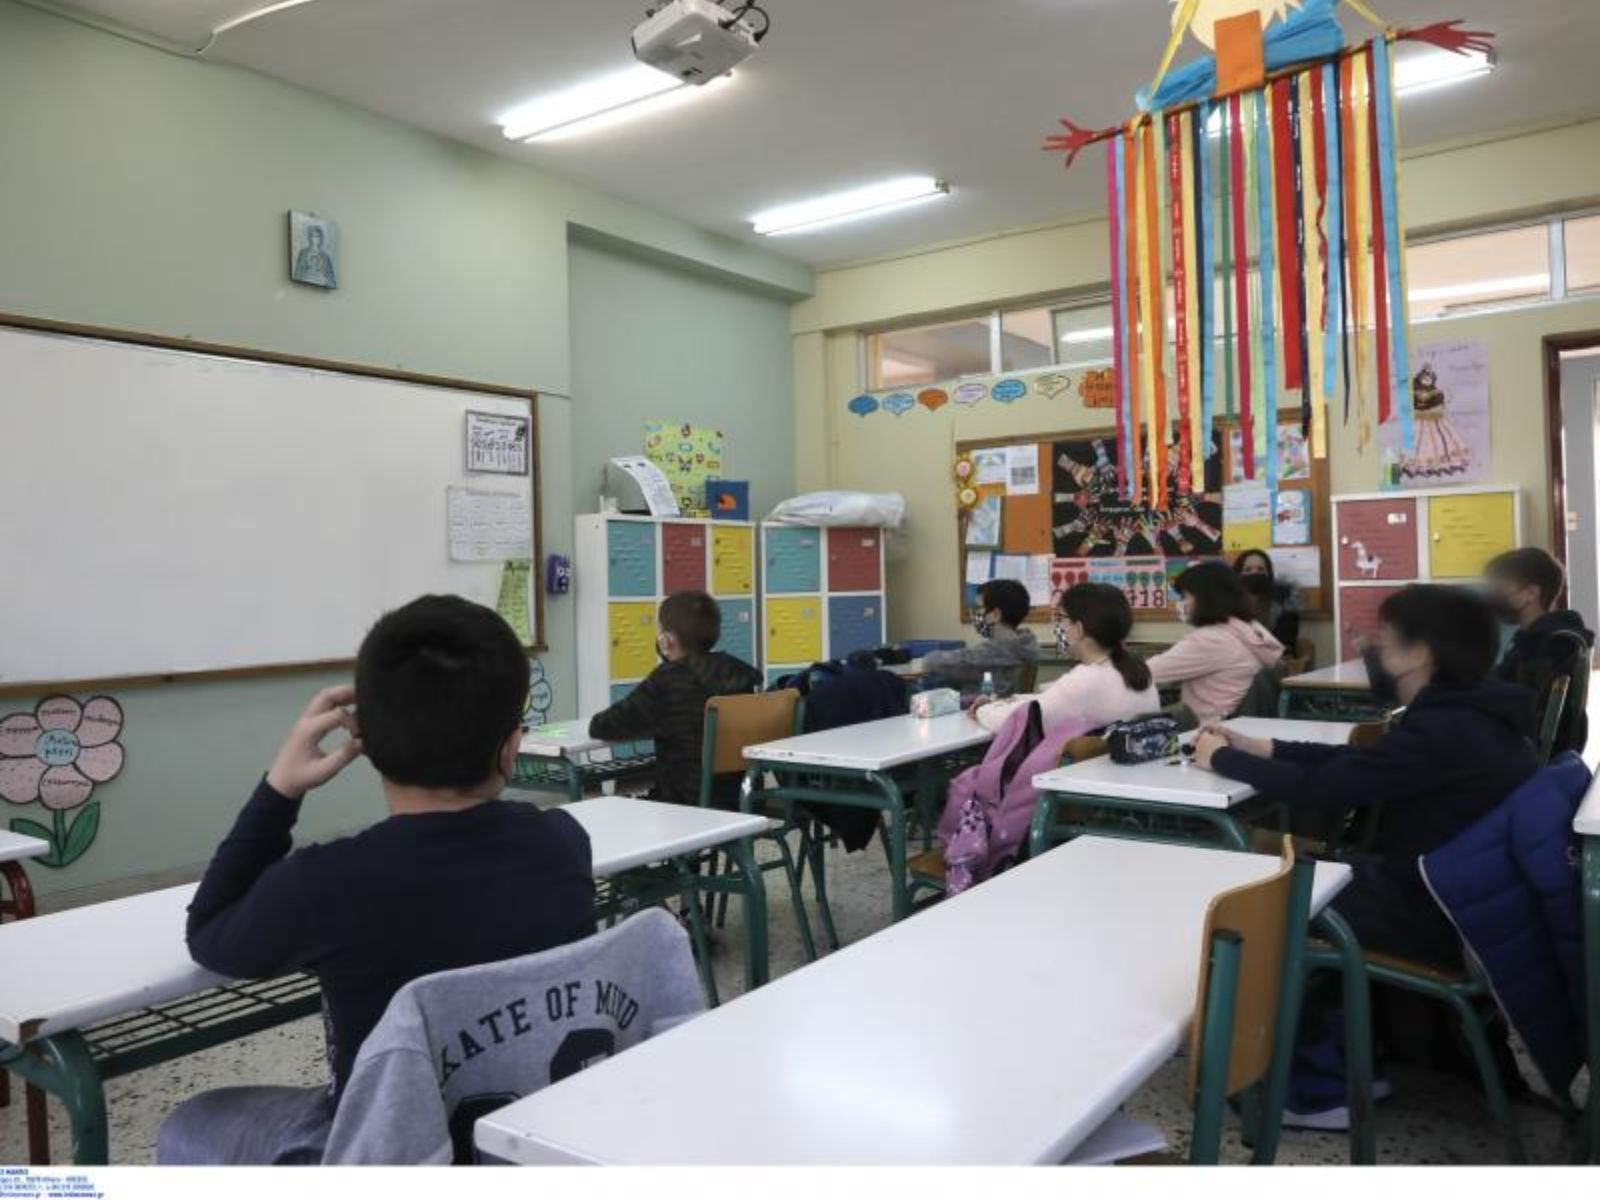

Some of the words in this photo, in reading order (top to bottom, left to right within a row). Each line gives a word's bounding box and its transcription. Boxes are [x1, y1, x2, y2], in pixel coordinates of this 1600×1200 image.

[440, 997, 532, 1089] KATE
[546, 981, 581, 1021] OF
[595, 980, 640, 1031] MIND
